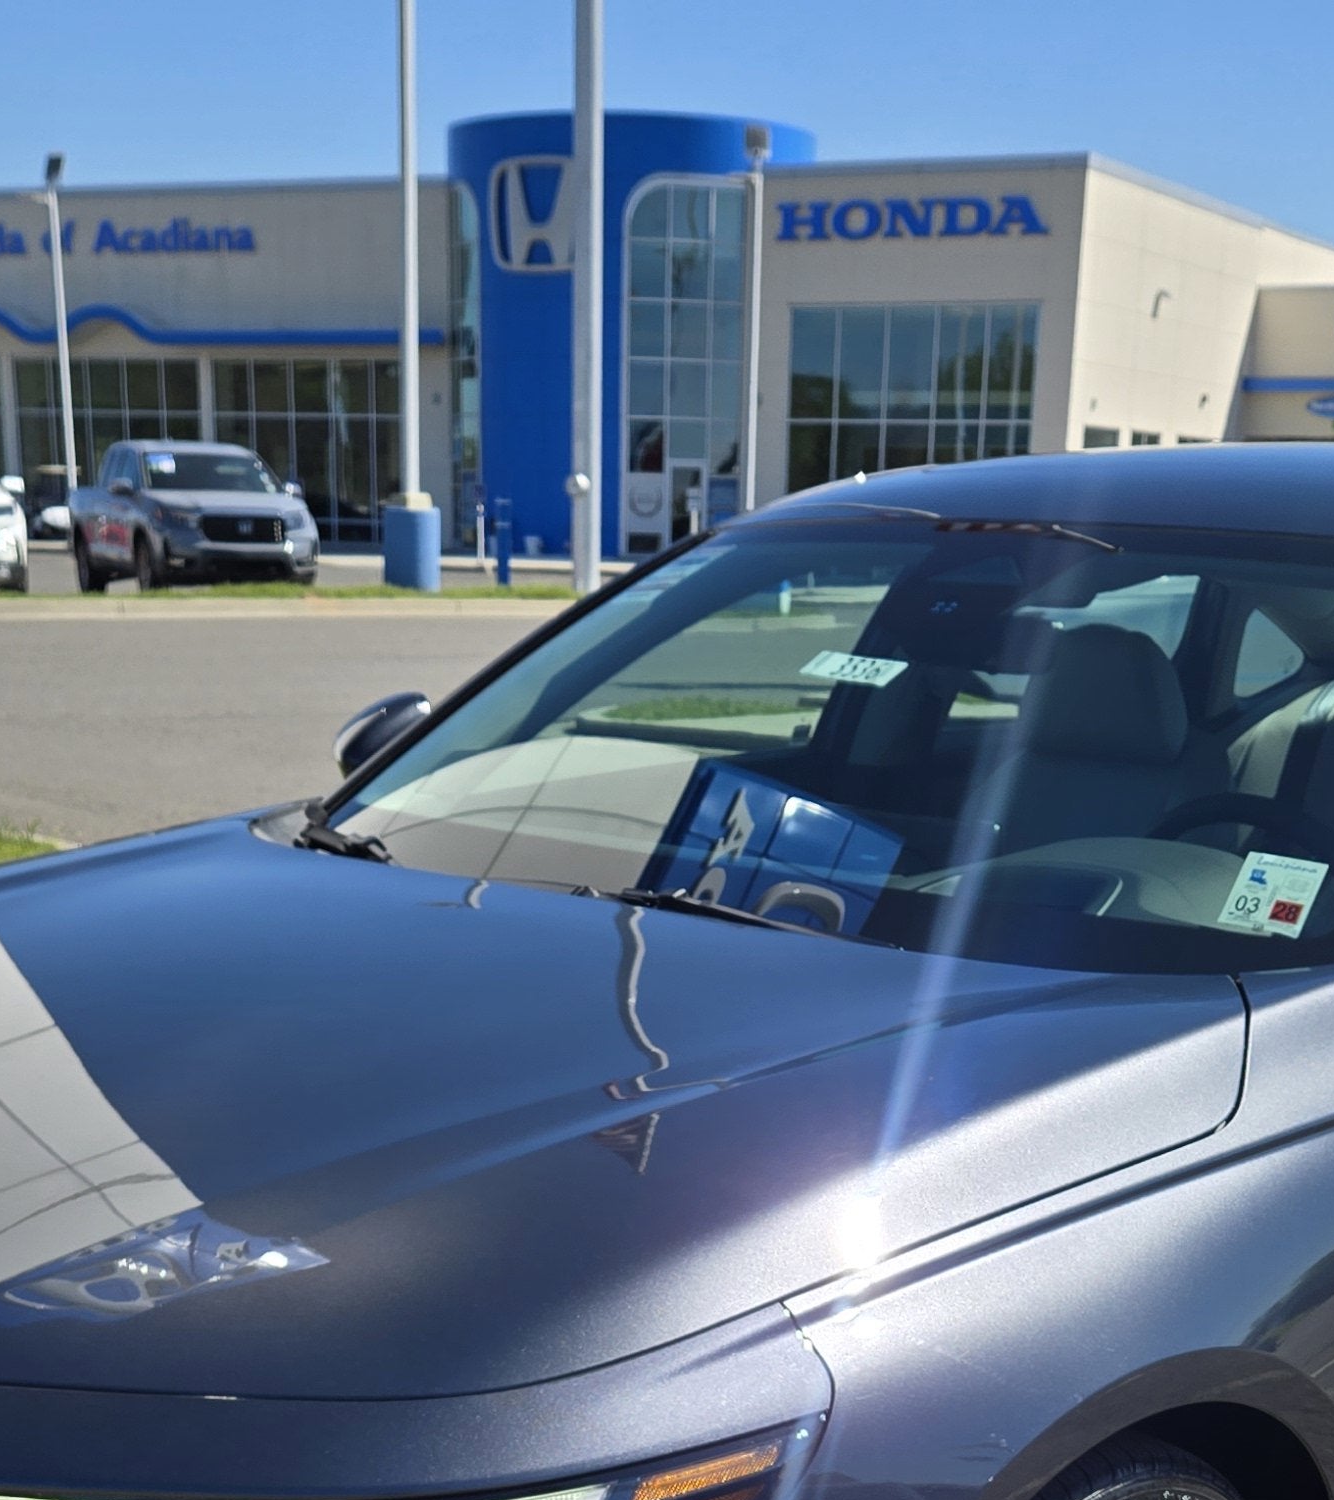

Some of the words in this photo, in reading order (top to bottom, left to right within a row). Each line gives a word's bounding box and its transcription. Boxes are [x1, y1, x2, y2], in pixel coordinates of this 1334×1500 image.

[92, 216, 256, 255] Acadiana
[775, 195, 1050, 242] HONDA
[1235, 894, 1261, 914] 03
[1271, 901, 1300, 923] 28
